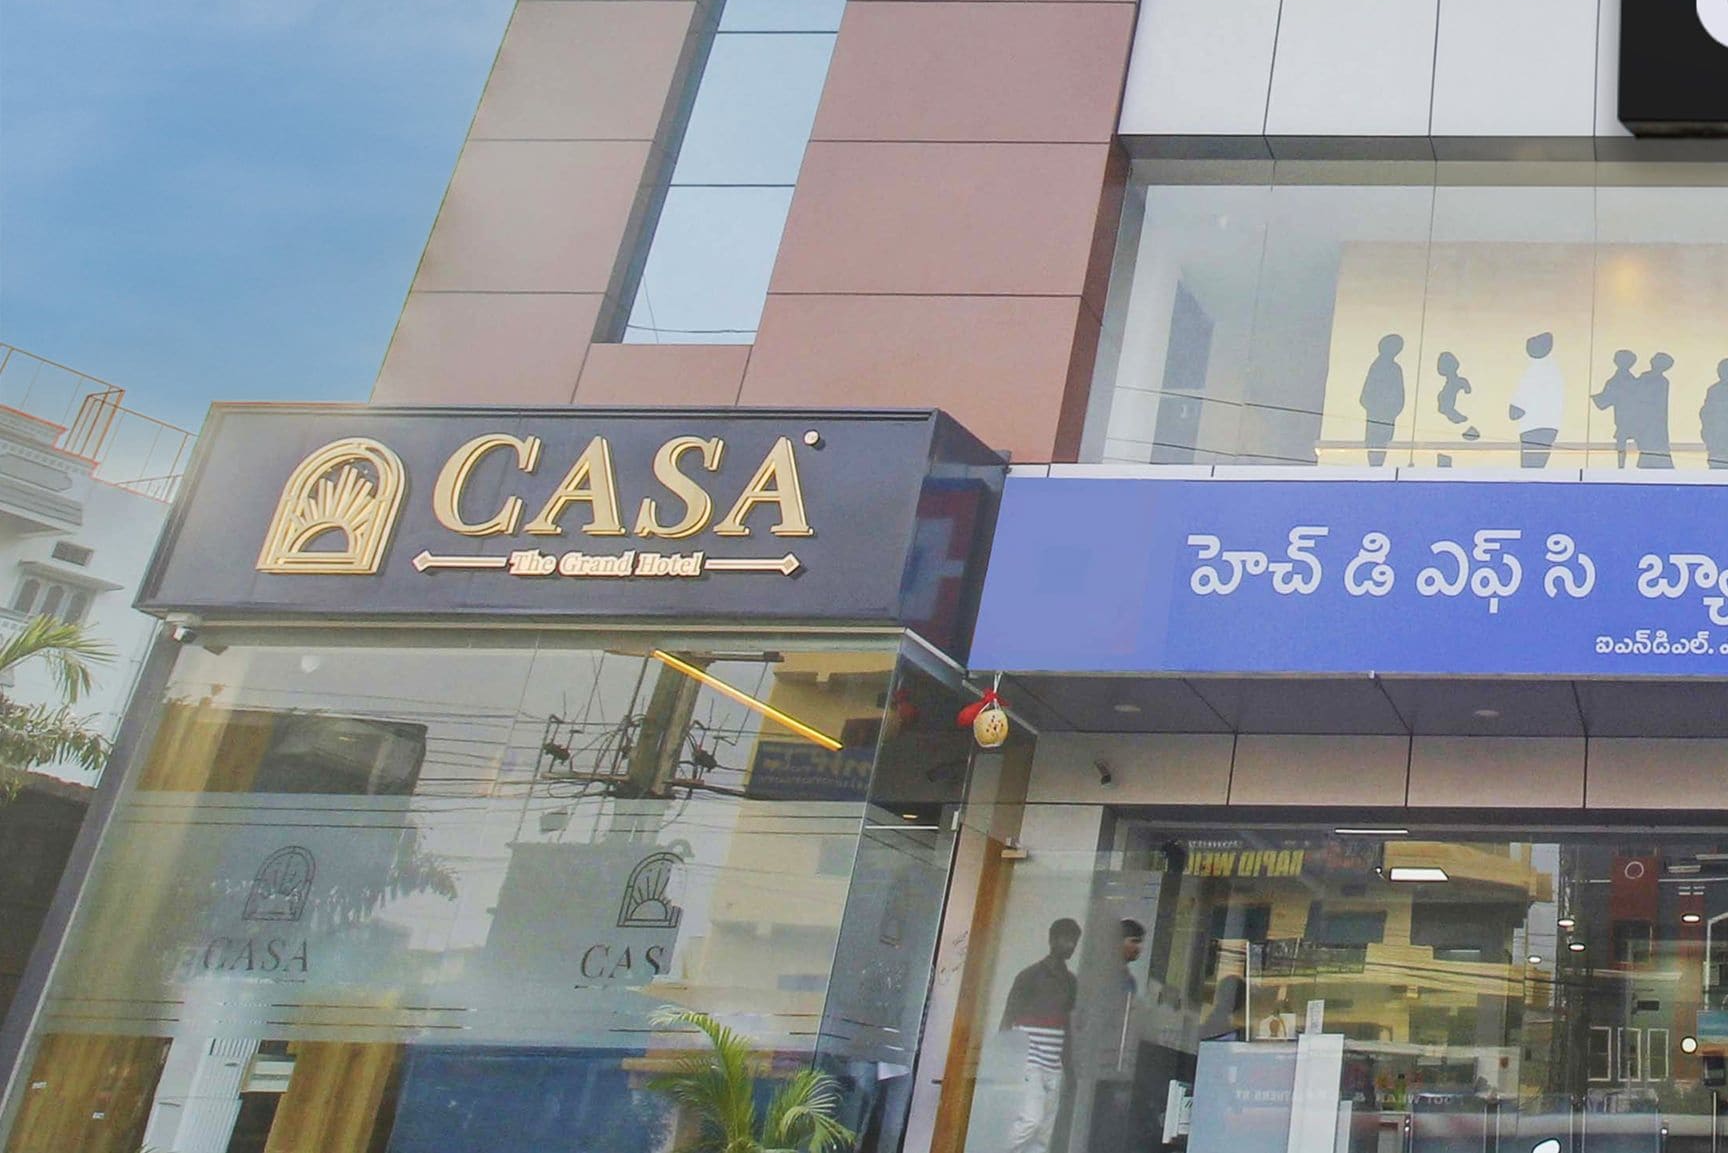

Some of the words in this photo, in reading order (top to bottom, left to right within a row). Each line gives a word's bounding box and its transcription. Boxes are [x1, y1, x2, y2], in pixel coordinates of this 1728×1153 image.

[432, 431, 815, 539] CASA
[509, 549, 557, 576] The
[558, 549, 634, 577] Grand
[634, 549, 706, 577] Hotel
[1186, 525, 1330, 597] హెచ్
[1343, 530, 1395, 597] డి
[1415, 528, 1523, 615] ఎఫ్
[1543, 533, 1596, 598] సి
[202, 935, 309, 973] CASA
